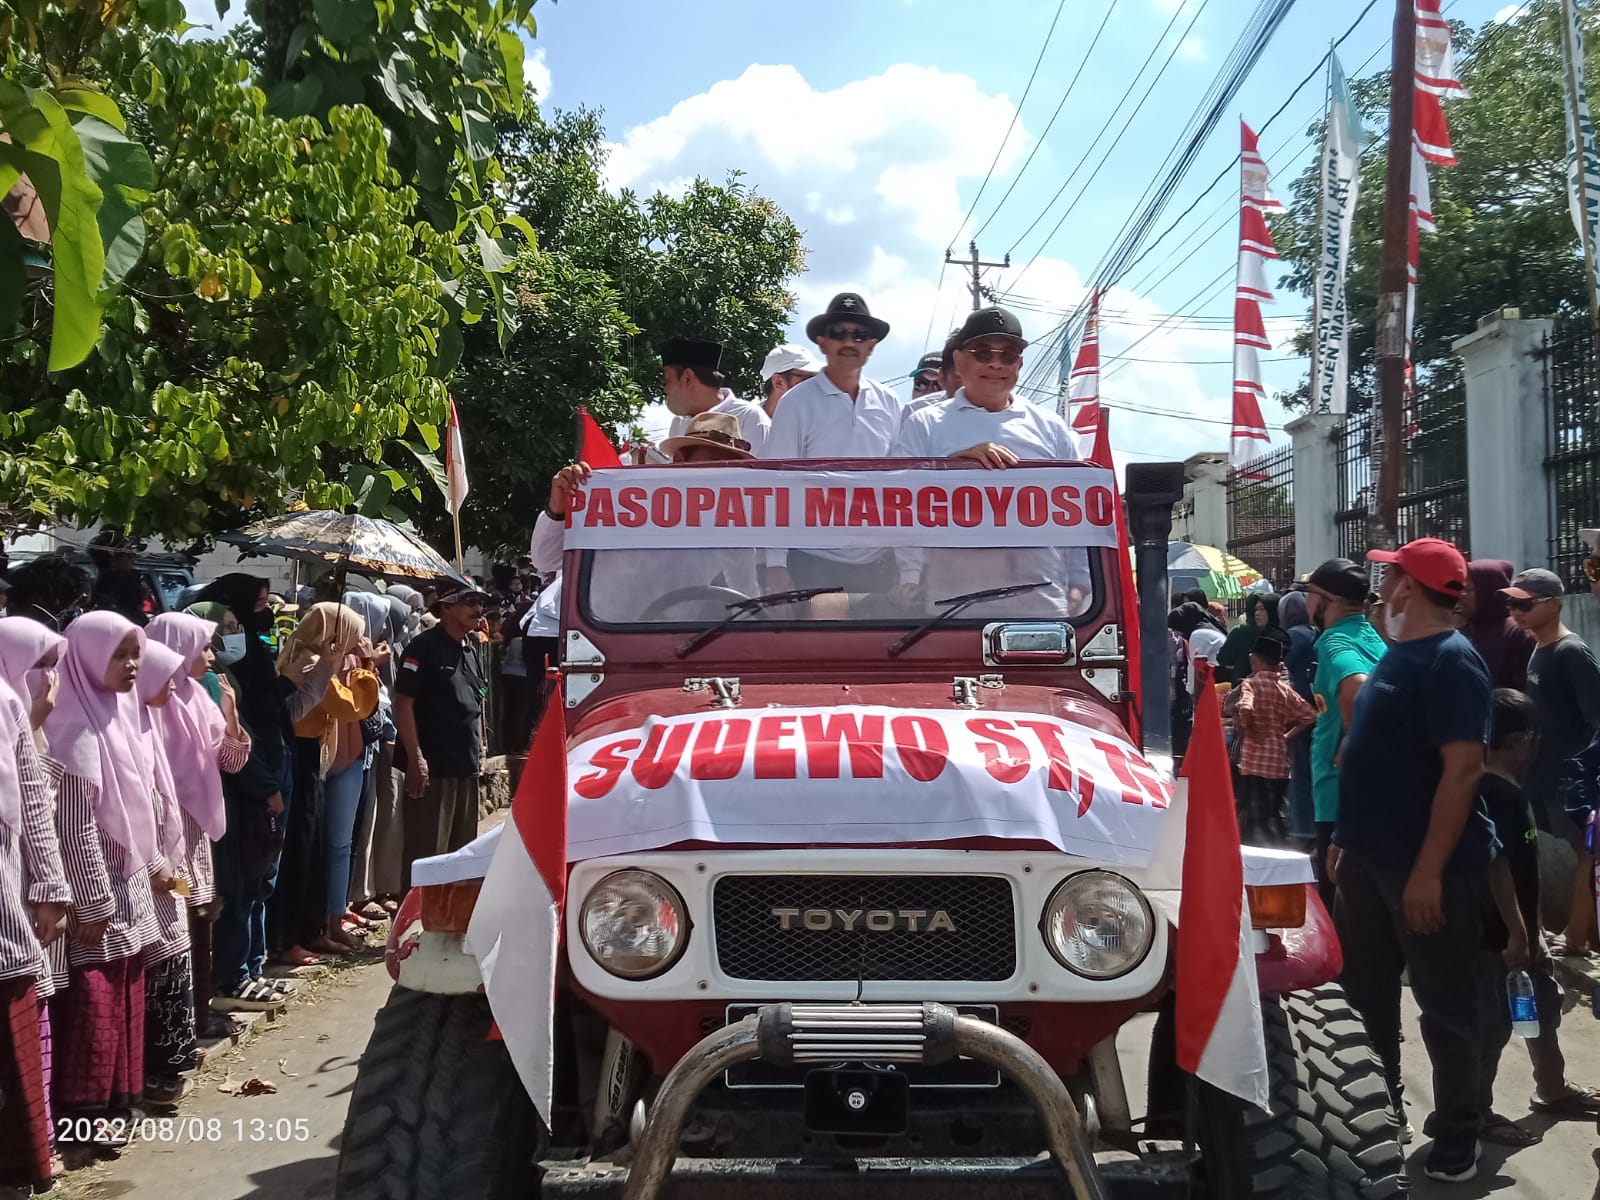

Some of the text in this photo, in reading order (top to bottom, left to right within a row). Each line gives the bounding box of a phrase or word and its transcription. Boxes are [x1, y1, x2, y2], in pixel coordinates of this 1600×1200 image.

[565, 486, 1112, 530] PASOPATI MARGOYOSO
[574, 713, 950, 799] SUDEWO
[774, 909, 957, 932] TOYOTA
